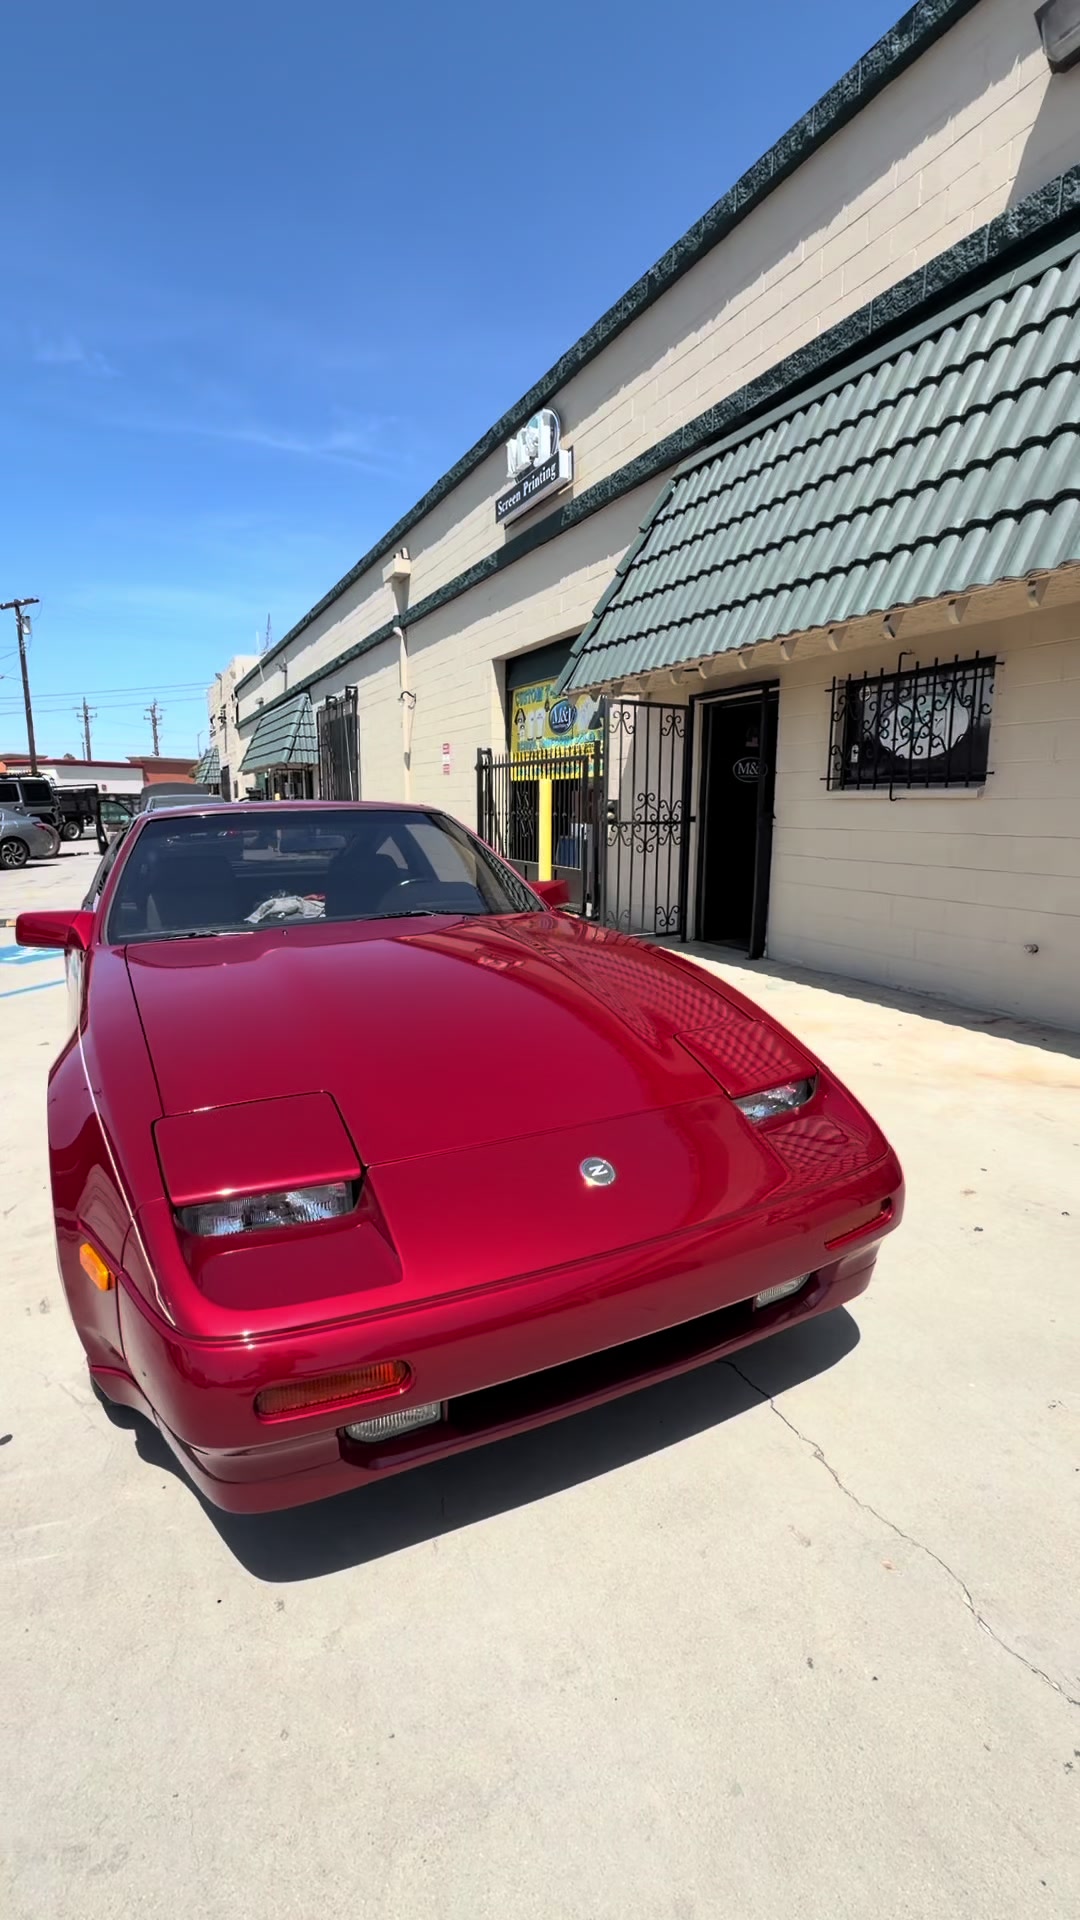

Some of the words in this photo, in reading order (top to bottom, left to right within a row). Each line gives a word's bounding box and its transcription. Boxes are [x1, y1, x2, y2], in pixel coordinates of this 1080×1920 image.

[497, 491, 521, 515] Screen
[522, 462, 557, 496] Printing
[737, 761, 760, 775] M&
[589, 1164, 608, 1177] Z
